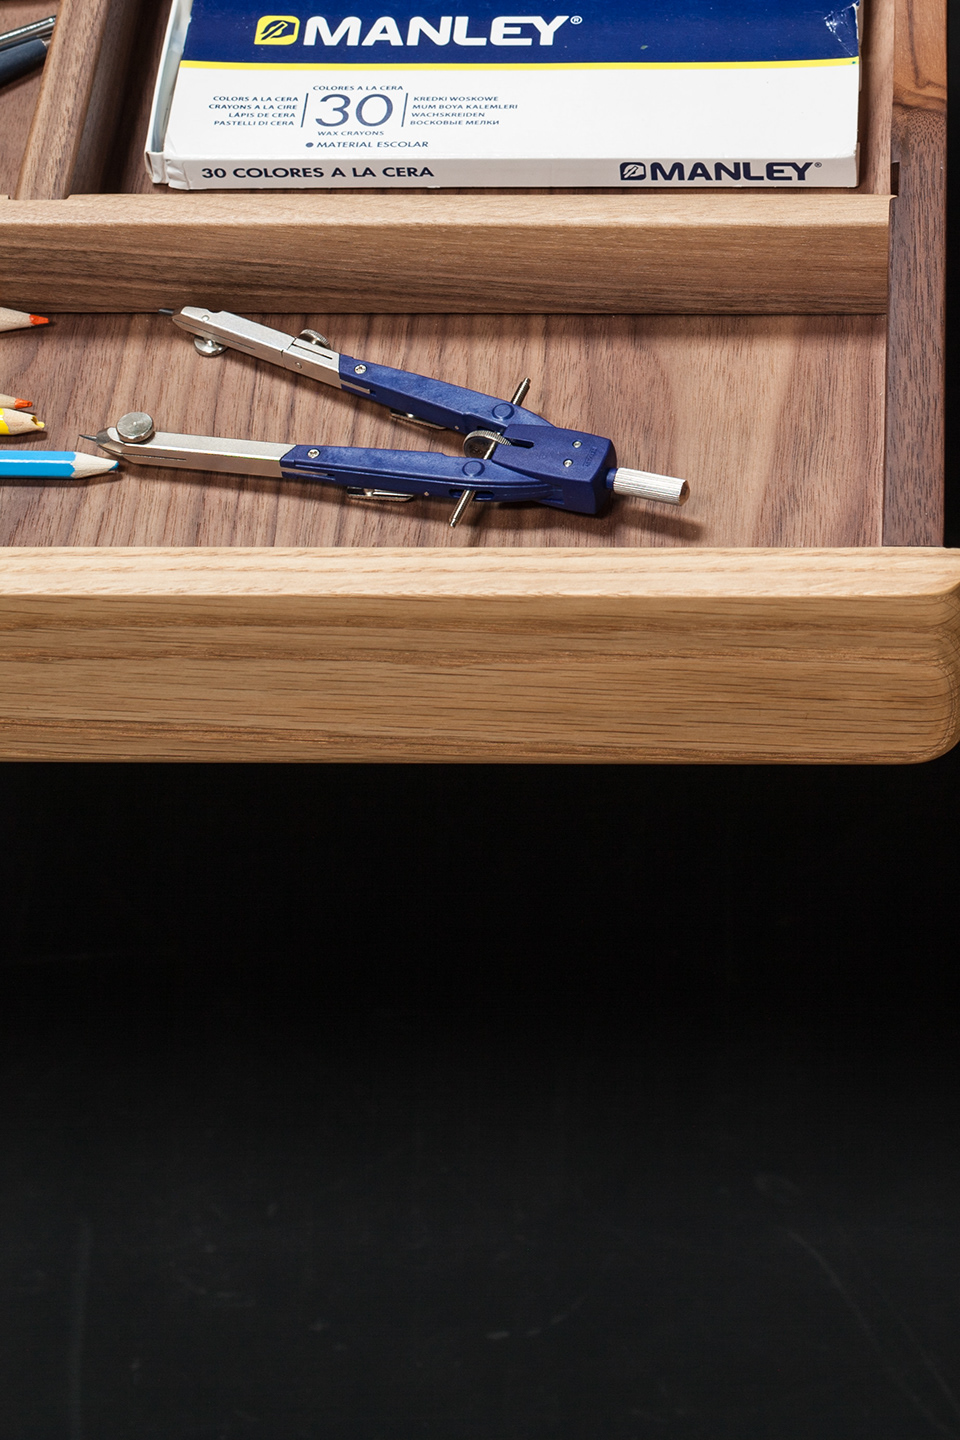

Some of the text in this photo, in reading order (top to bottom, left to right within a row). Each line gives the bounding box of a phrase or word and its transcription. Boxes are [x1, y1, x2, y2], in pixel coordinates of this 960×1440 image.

[315, 93, 394, 127] 30
[201, 166, 435, 179] 30 COLORES A LA CERA
